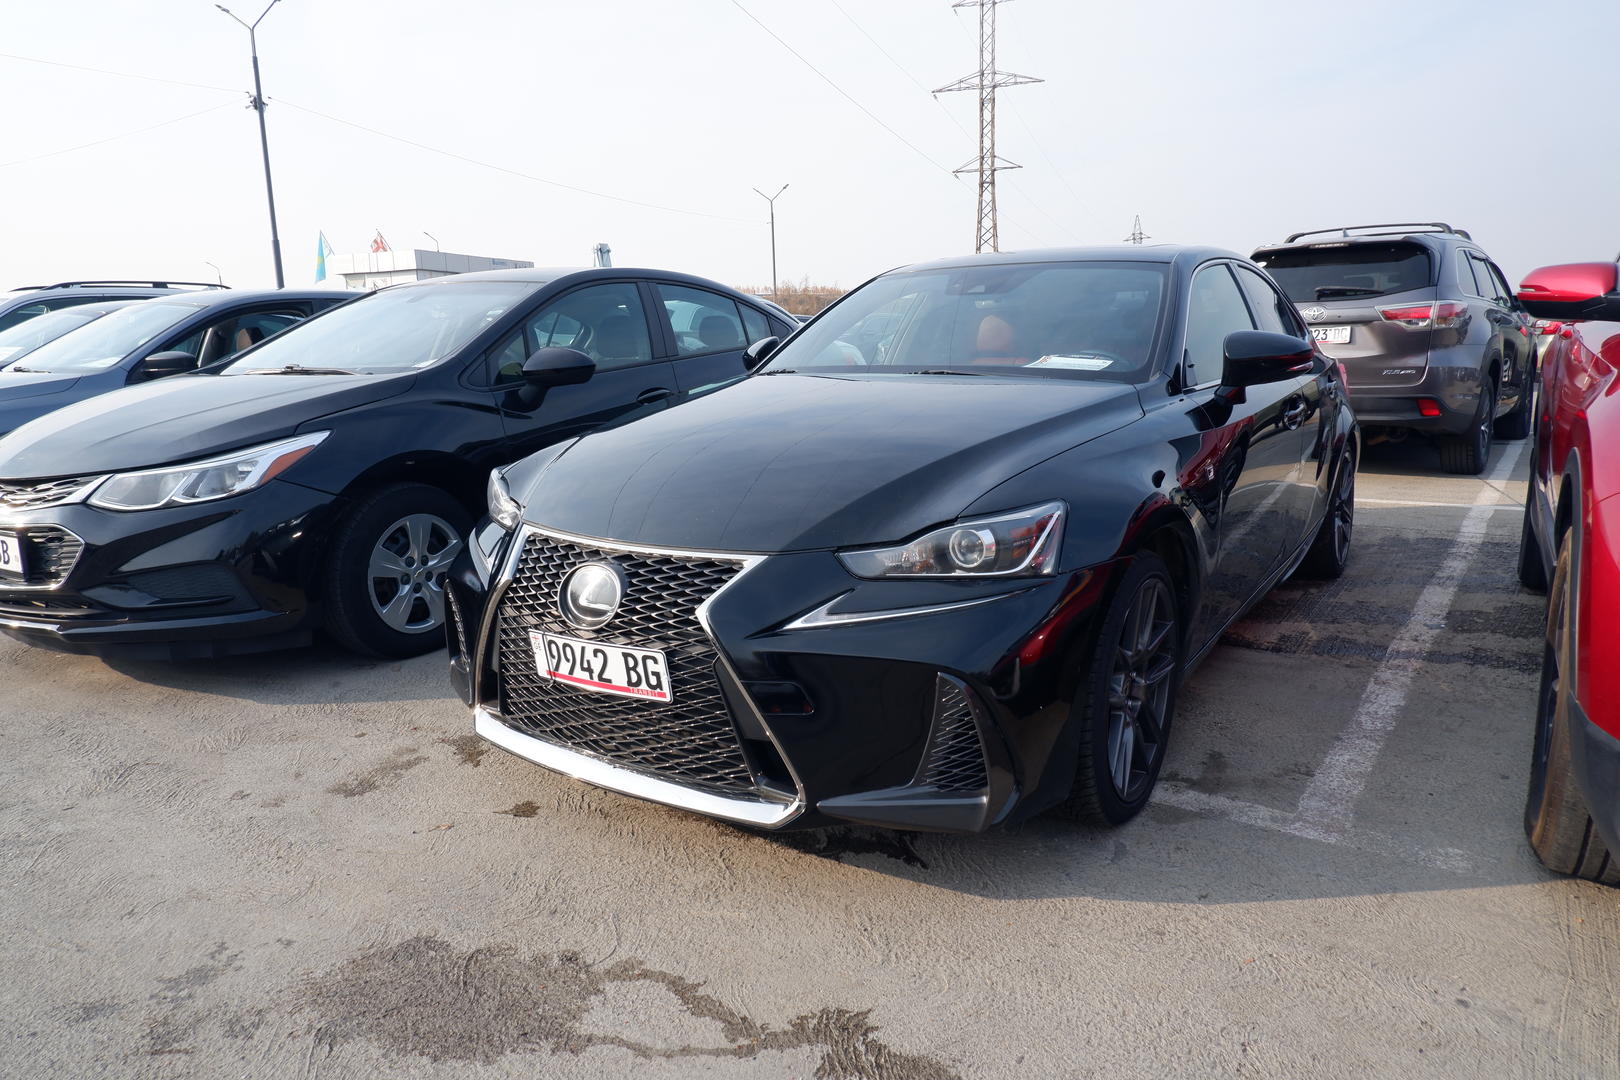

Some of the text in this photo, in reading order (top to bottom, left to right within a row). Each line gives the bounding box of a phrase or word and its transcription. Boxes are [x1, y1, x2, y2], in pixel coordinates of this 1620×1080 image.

[0, 539, 10, 565] B
[547, 639, 664, 691] 9942 BG
